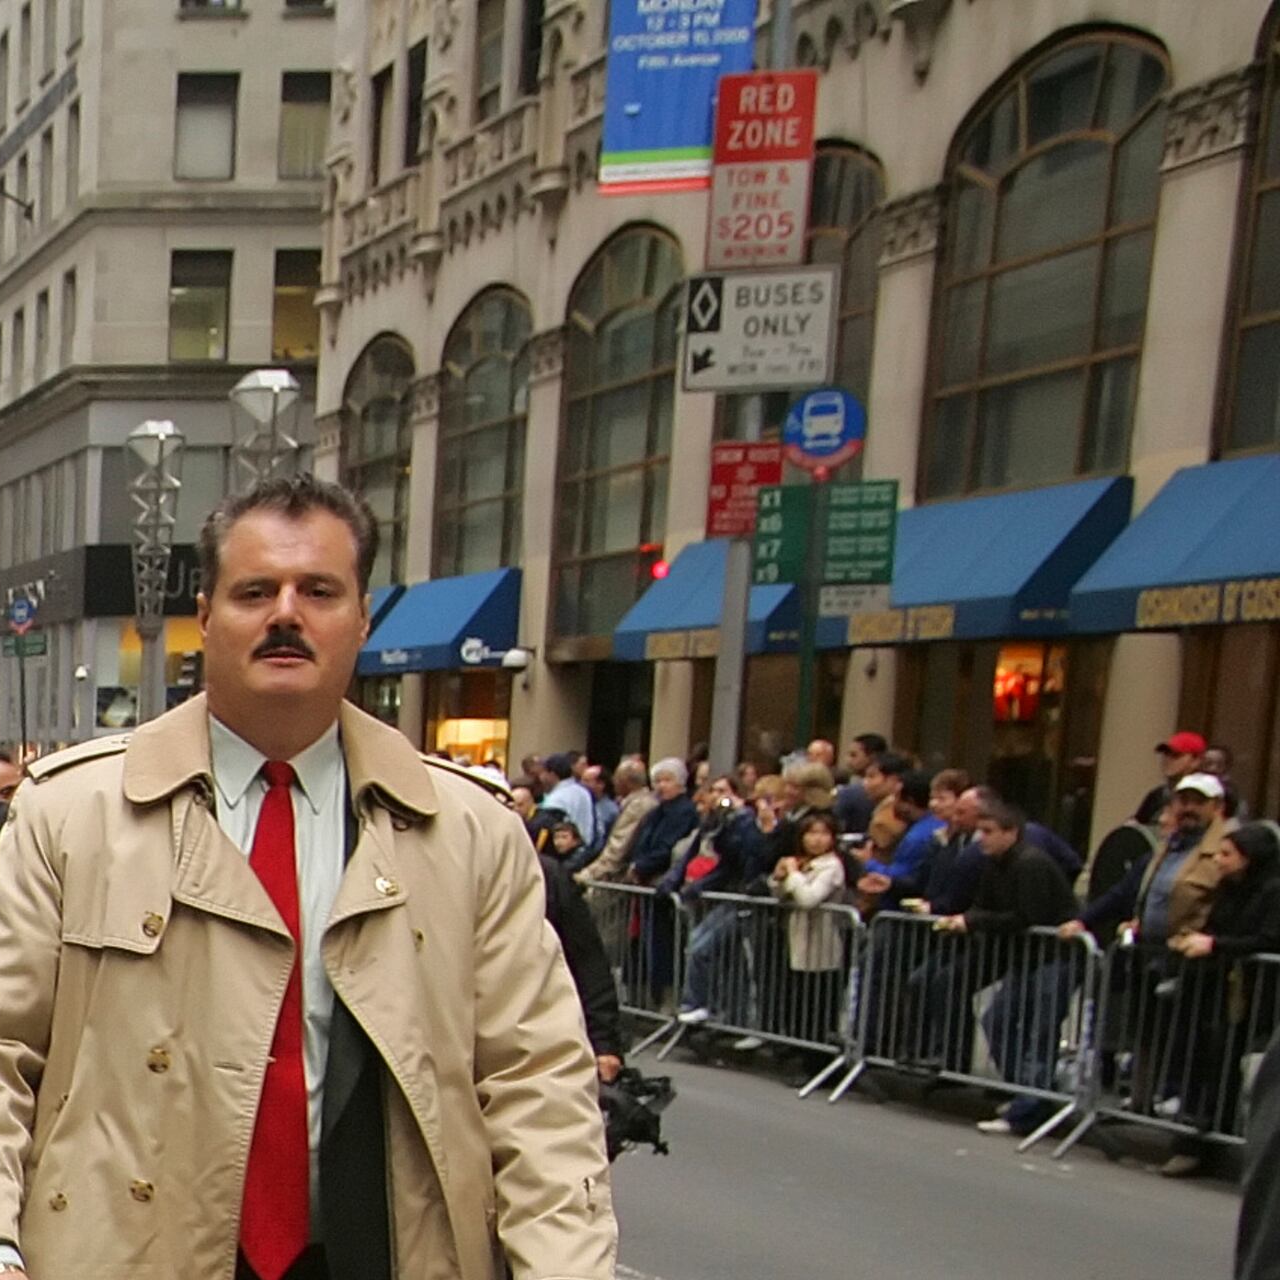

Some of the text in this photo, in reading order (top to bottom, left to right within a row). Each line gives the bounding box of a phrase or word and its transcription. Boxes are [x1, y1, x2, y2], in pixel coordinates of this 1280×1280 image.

[693, 12, 721, 27] PM
[612, 34, 690, 52] OCTOBER
[672, 53, 722, 67] Avenue
[740, 82, 795, 115] RED
[726, 117, 802, 150] ZONE
[726, 169, 767, 188] TOW
[777, 168, 790, 185] &
[731, 192, 781, 210] FINE
[716, 211, 795, 242] $205
[735, 279, 824, 308] BUSES
[743, 313, 812, 338] ONLY
